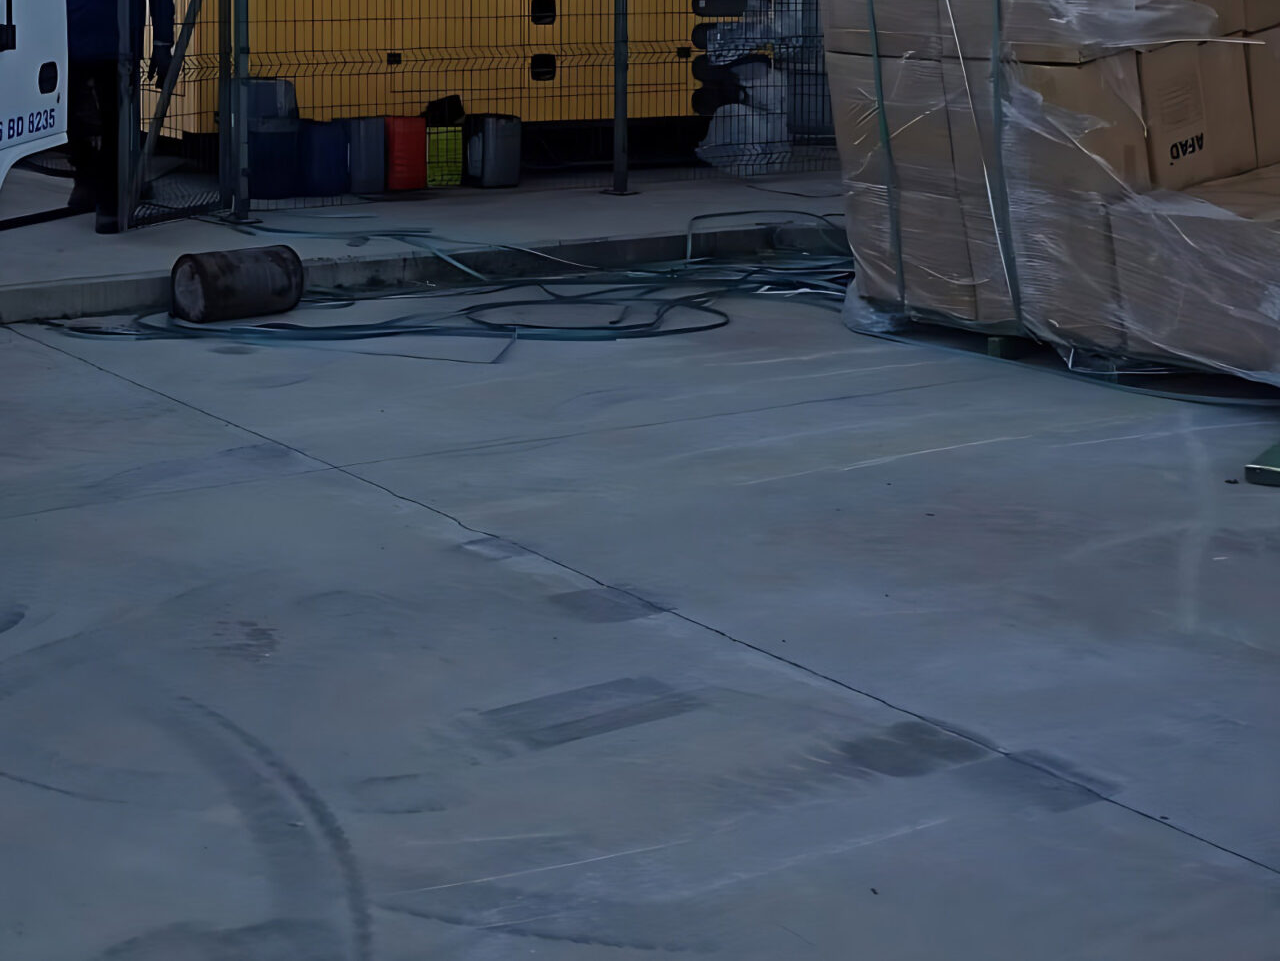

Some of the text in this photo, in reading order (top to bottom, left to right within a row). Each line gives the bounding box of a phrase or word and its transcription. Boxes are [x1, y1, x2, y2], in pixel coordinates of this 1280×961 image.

[7, 116, 24, 140] BD
[28, 108, 55, 134] 8235
[1170, 132, 1204, 160] AFAD
